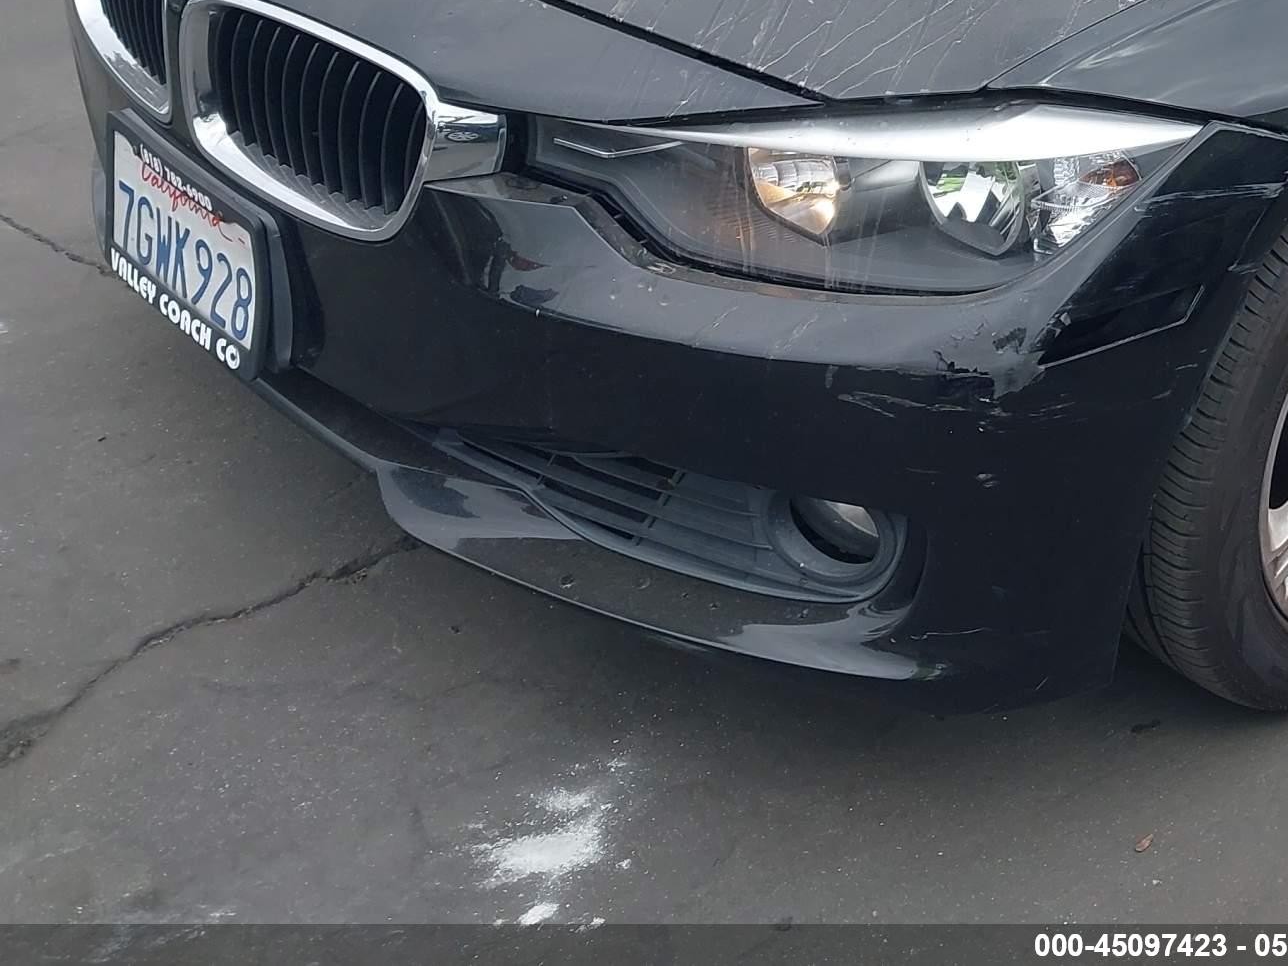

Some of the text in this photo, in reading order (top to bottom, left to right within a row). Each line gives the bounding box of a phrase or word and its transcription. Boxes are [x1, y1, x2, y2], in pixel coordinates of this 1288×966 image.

[140, 143, 214, 212] (818) 782-6900
[110, 246, 241, 371] VALLEY COACH CO
[117, 178, 253, 342] 7GWK928
